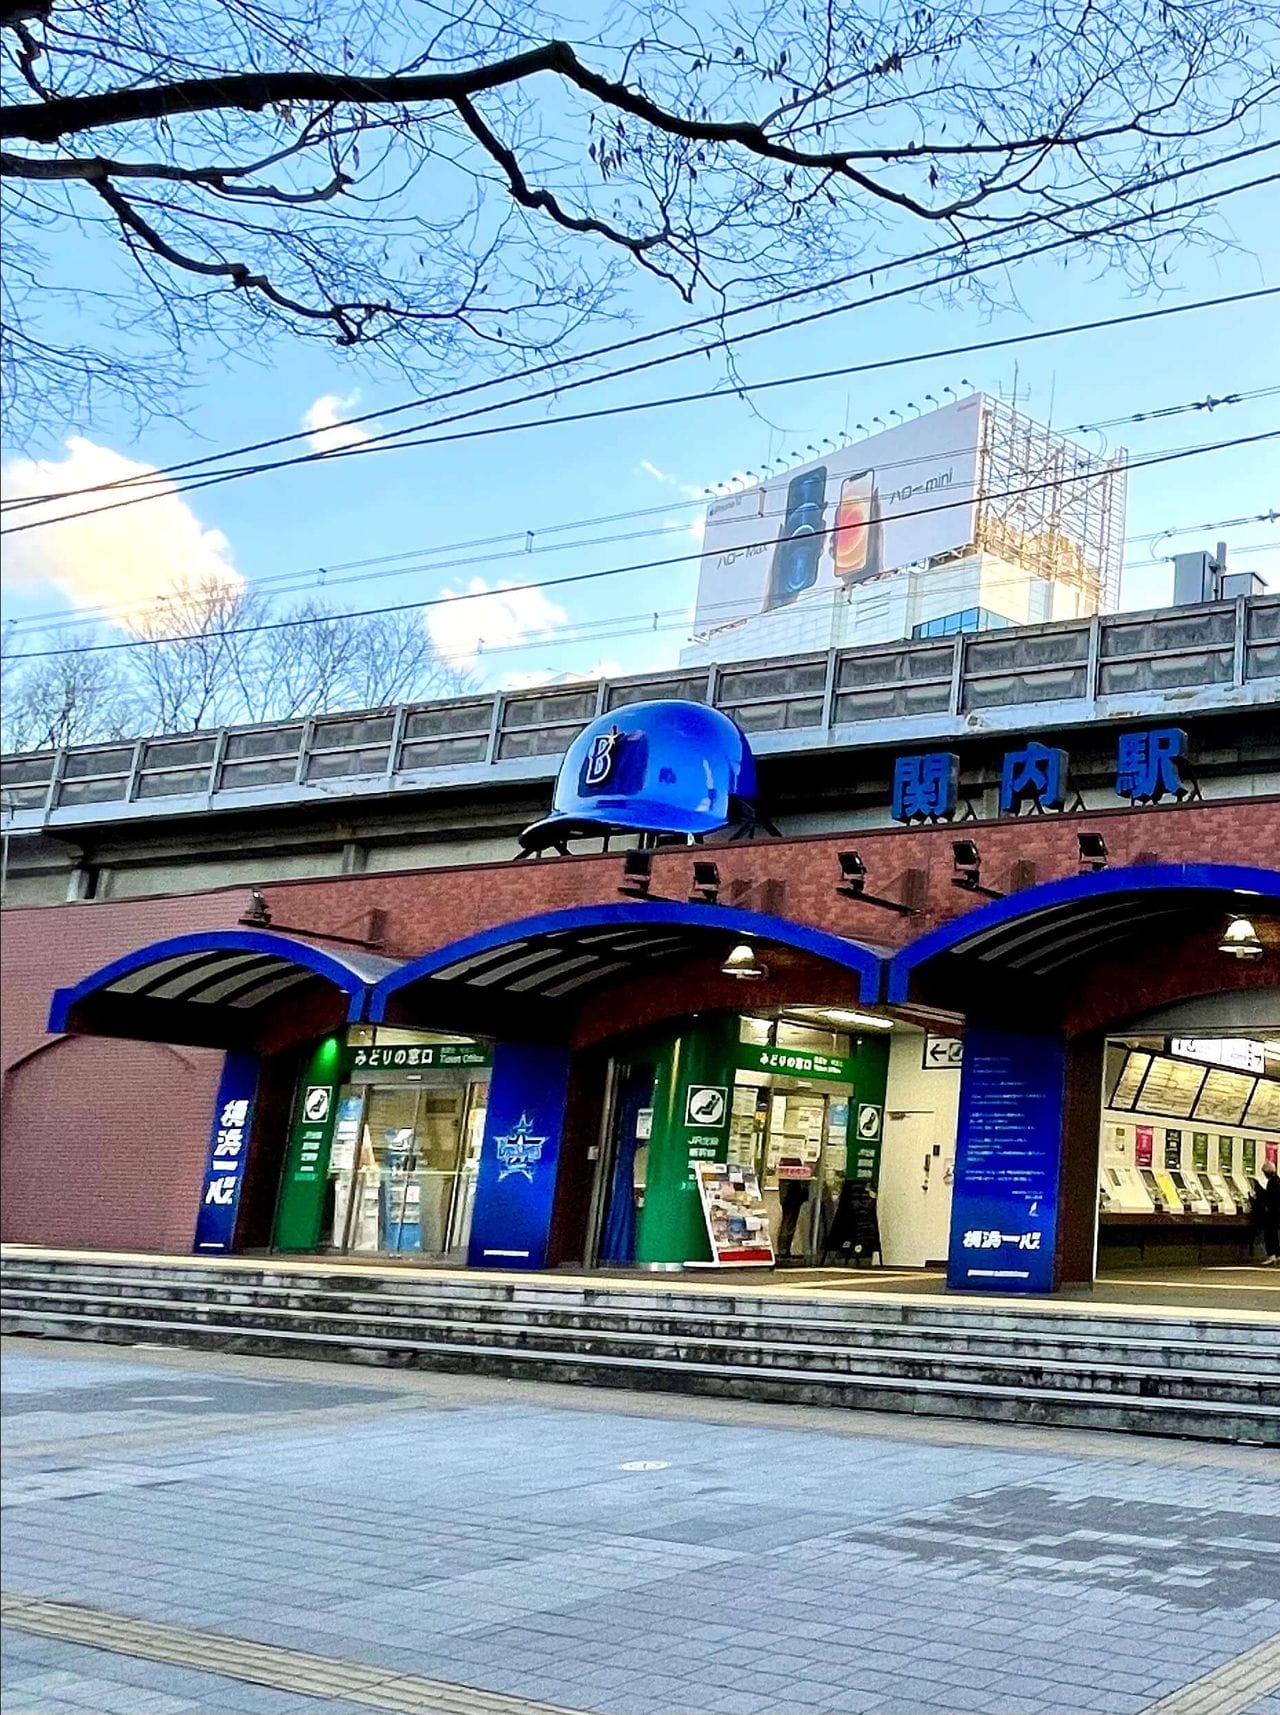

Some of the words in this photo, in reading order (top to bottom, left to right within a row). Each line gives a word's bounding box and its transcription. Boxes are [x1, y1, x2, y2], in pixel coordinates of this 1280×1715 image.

[891, 728, 1187, 821] 関内駅
[355, 1048, 433, 1066] みどりの窓口
[962, 1230, 1042, 1250] 横浜一心
